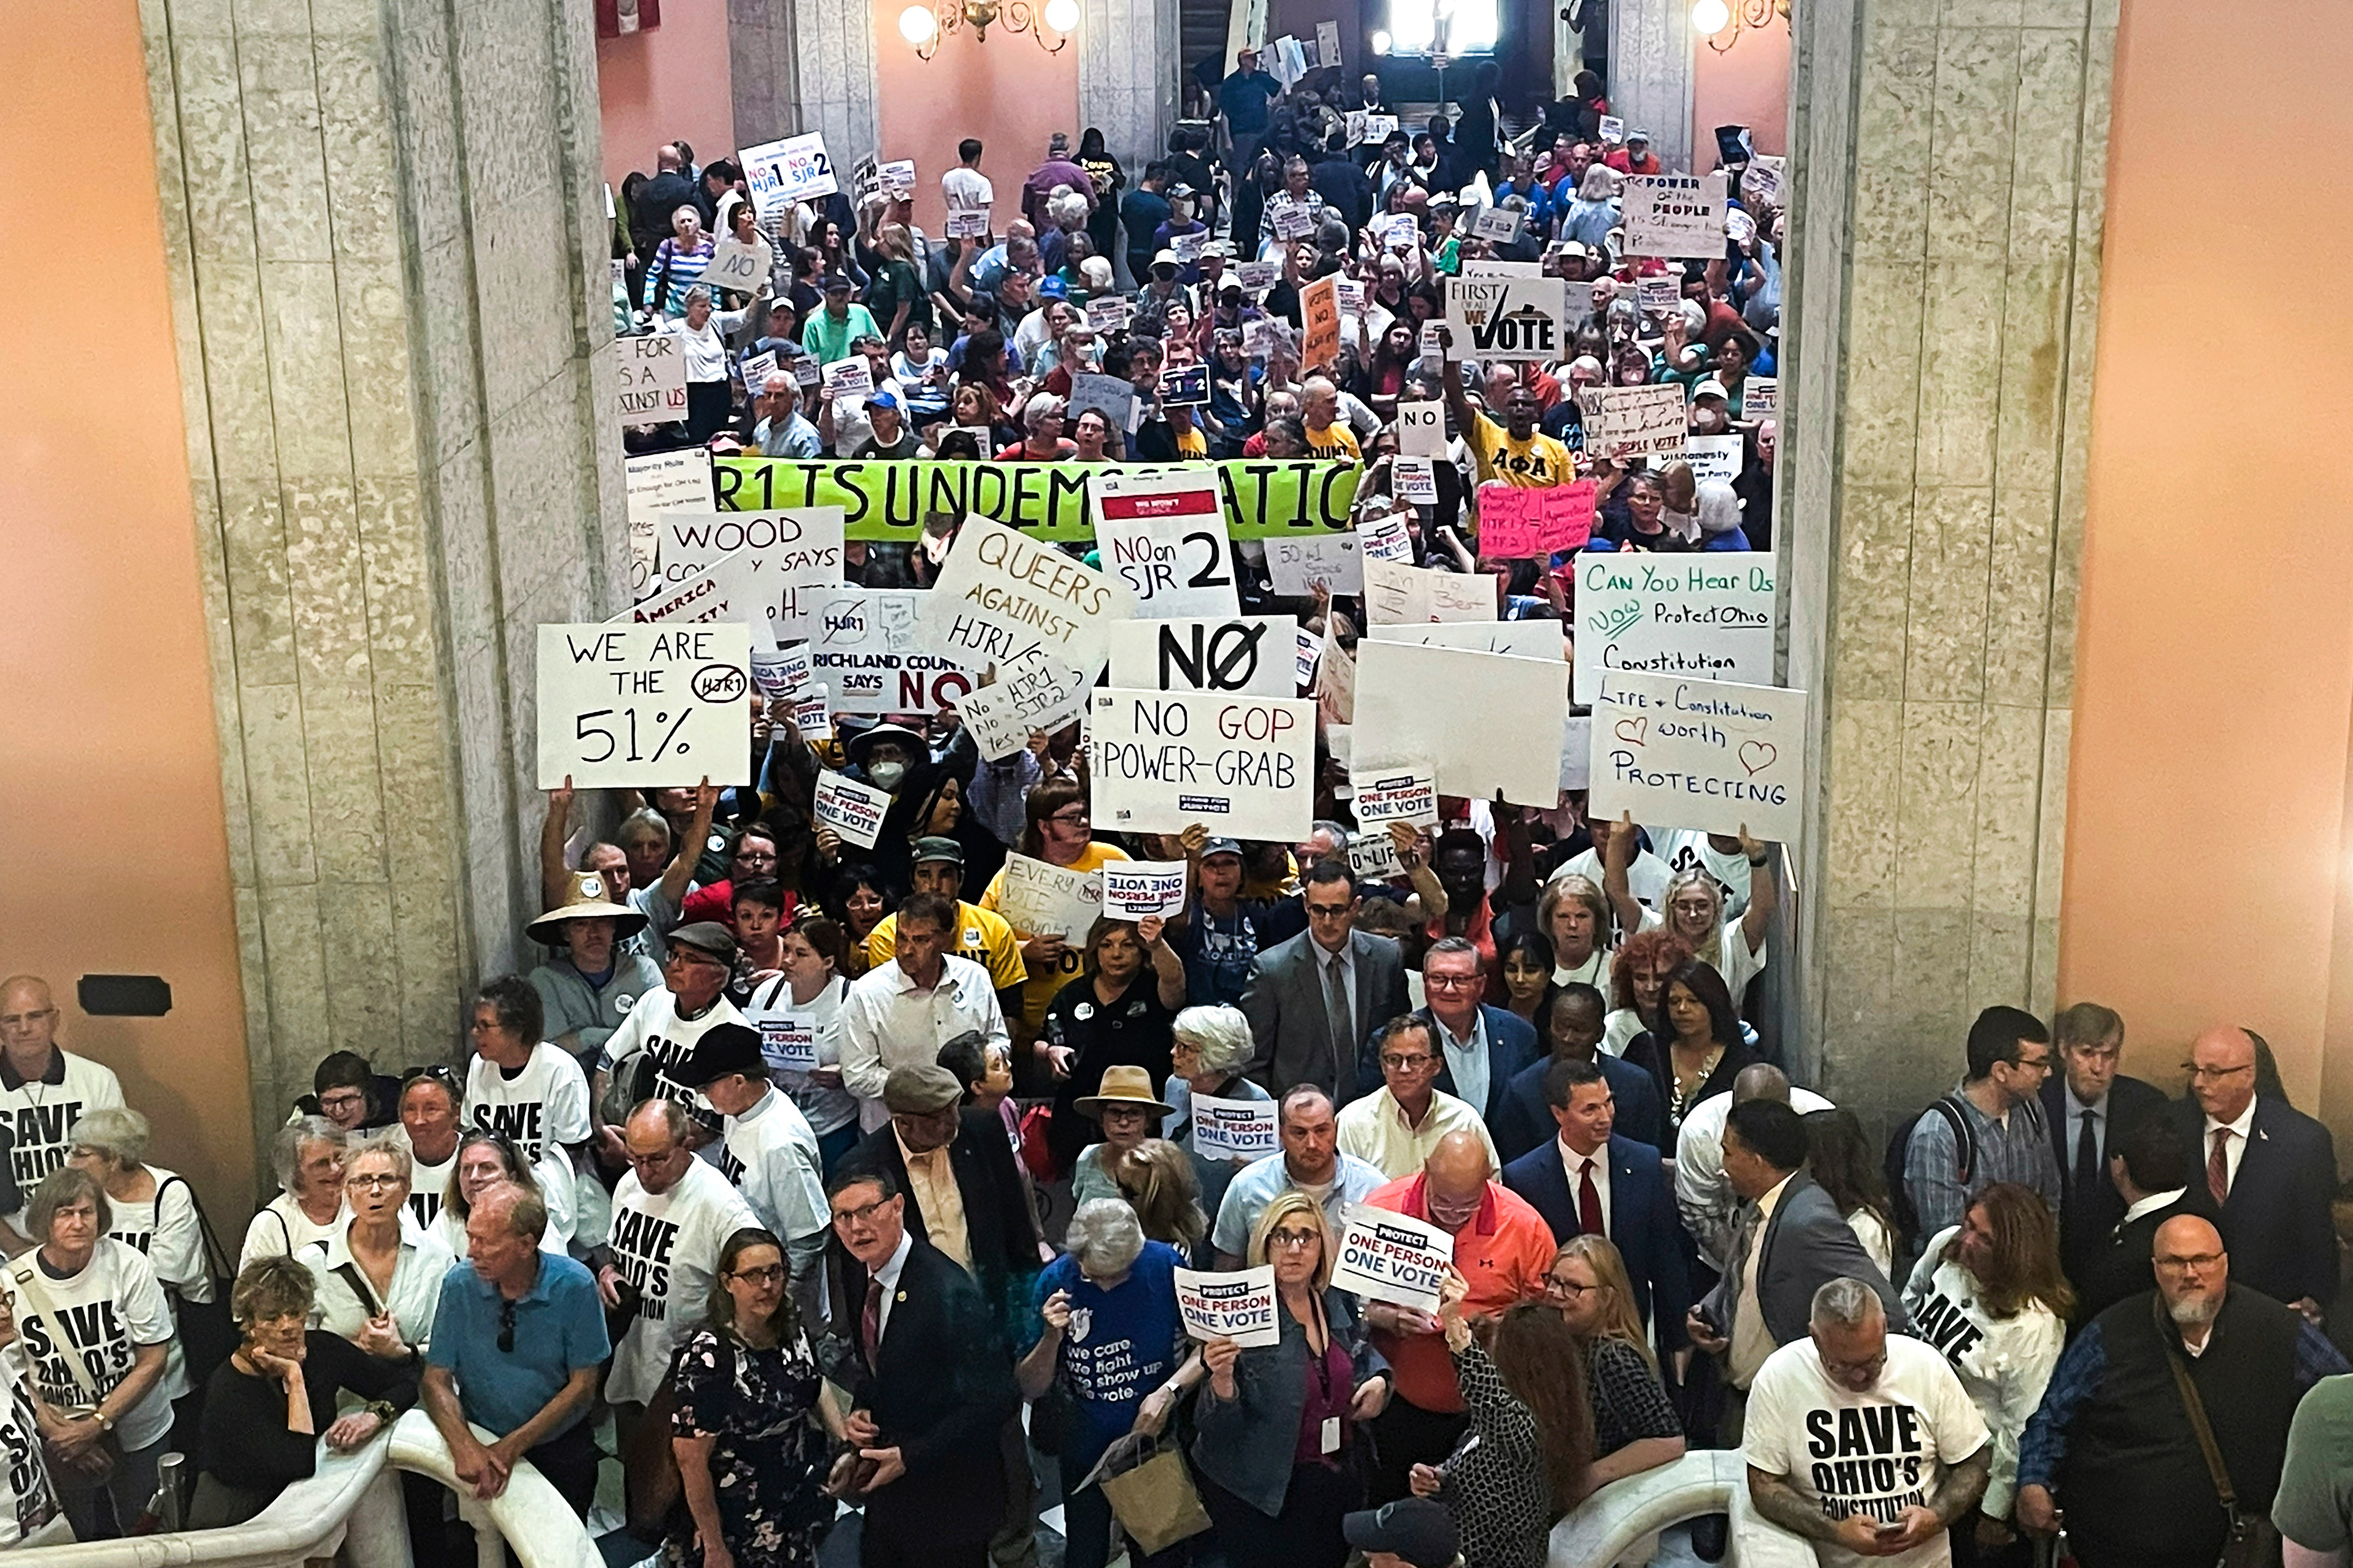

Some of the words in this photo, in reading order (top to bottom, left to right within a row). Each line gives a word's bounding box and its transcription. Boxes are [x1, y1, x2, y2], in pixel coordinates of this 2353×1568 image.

[749, 167, 767, 180] NO
[789, 157, 807, 170] NO
[813, 153, 830, 175] 2
[1647, 177, 1699, 189] POWER
[1653, 203, 1710, 216] PEOPLE
[723, 254, 755, 276] NO
[1452, 282, 1500, 300] FIRST
[1464, 310, 1487, 325] WE
[1472, 284, 1554, 350] VOTE
[636, 337, 673, 358] FOR
[641, 366, 656, 385] A
[1194, 378, 1205, 390] 2
[666, 387, 686, 407] US
[1404, 410, 1436, 426] NO
[886, 463, 1355, 529] UNDEMATIC
[1405, 482, 1432, 491] VOTE
[673, 517, 802, 551] WOOD
[781, 547, 839, 572] SAYS
[1114, 536, 1152, 564] NO
[1154, 545, 1176, 562] on
[979, 533, 1111, 615] QUEERS
[1120, 564, 1177, 600] SJR
[1182, 531, 1230, 588] 2
[634, 579, 716, 623] AMERICA
[965, 582, 1079, 643] AGAINST
[566, 633, 627, 663] WE
[650, 632, 715, 662] ARE
[1603, 644, 1735, 671] Constitution
[813, 653, 902, 669] RICHLAND
[906, 655, 971, 672] COUN
[610, 670, 665, 695] THE
[843, 675, 883, 689] SAYS
[899, 670, 972, 711] NO
[1007, 667, 1058, 703] HJR1
[1675, 684, 1773, 722] Constitution
[1135, 700, 1188, 737] NO
[1219, 705, 1295, 743] GOP
[576, 707, 693, 763] 51%
[1104, 742, 1296, 789] POWER-GRAB
[1610, 750, 1787, 806] PROTECTING
[818, 791, 837, 805] ONE
[838, 799, 881, 820] PERSON
[1359, 793, 1383, 804] ONE
[1386, 785, 1432, 800] PERSON
[816, 800, 841, 819] ONE
[843, 811, 877, 832] VOTE
[1361, 802, 1392, 817] ONE
[1394, 796, 1432, 813] VOTE
[1109, 877, 1146, 890] VOTE
[1150, 878, 1183, 890] ONE
[1109, 890, 1155, 902] PERSON
[1158, 889, 1182, 901] ONE
[768, 1033, 812, 1043] PERSON
[779, 1045, 814, 1057] VOTE
[474, 1102, 543, 1138] SAVE
[1196, 1115, 1220, 1131] ONE
[1223, 1121, 1274, 1132] PERSON
[1196, 1126, 1230, 1144] ONE
[1232, 1132, 1274, 1145] VOTE
[613, 1206, 681, 1265] SAVE
[1379, 1226, 1426, 1248] PROTECT
[1349, 1233, 1381, 1254] ONE
[1384, 1242, 1446, 1273] PERSON
[1344, 1248, 1385, 1276] ONE
[1391, 1262, 1442, 1290] VOTE
[1201, 1285, 1248, 1297] PROTECT
[1181, 1294, 1209, 1311] ONE
[1212, 1294, 1271, 1312] PERSON
[1184, 1309, 1218, 1328] ONE
[1222, 1308, 1272, 1329] VOTE
[1915, 1293, 1984, 1367] AVE
[1096, 1369, 1140, 1388] show
[1806, 1405, 1922, 1459] SAVE
[1811, 1456, 1922, 1495] OHIO'S
